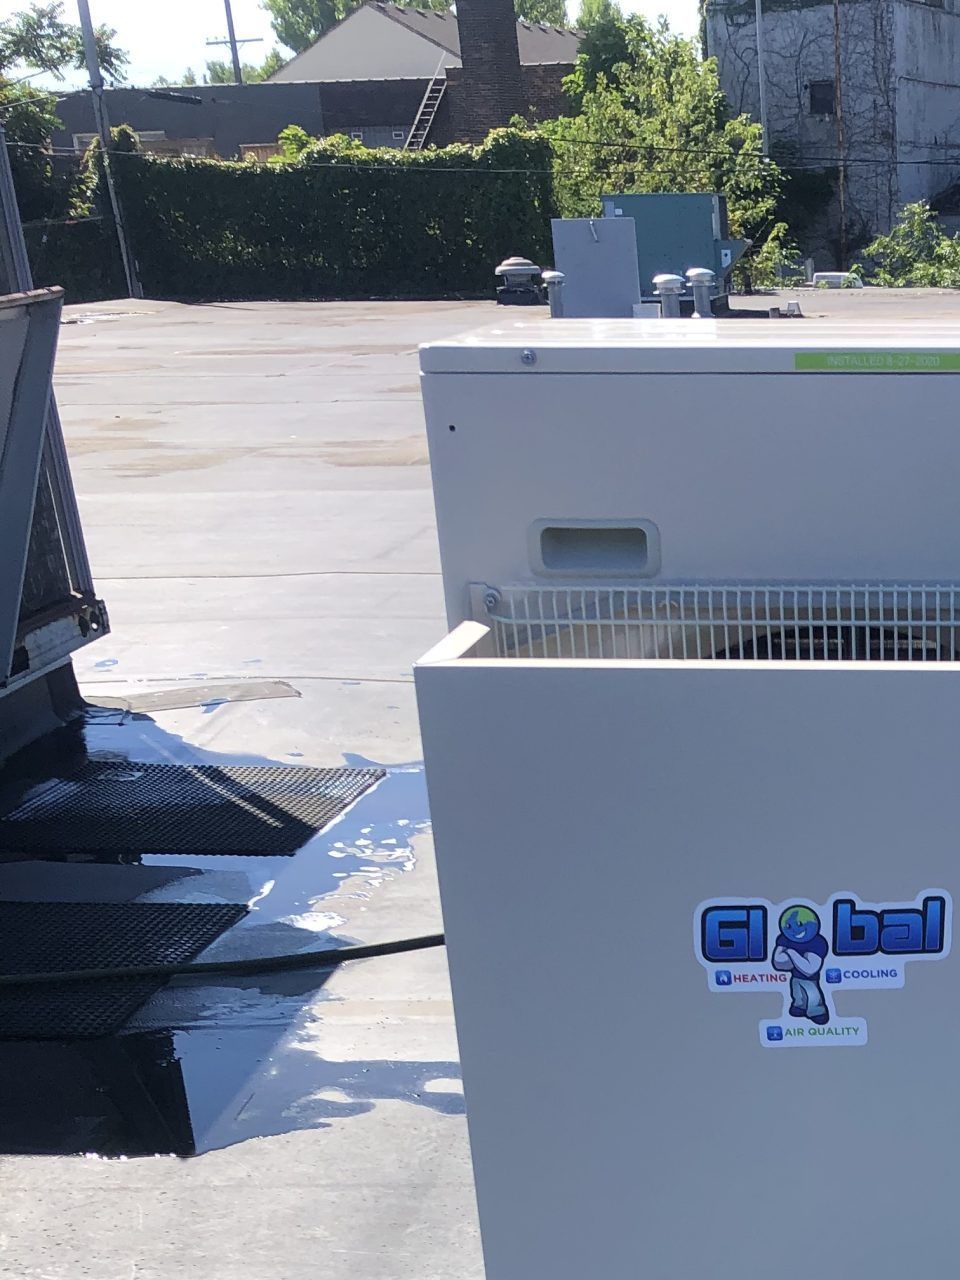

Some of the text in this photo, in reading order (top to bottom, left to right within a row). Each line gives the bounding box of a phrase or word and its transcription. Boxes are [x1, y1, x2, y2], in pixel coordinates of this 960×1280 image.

[827, 356, 883, 367] INSTALLED
[733, 974, 787, 983] HEATING
[843, 969, 897, 979] COOLING
[785, 1026, 860, 1037] AIR QUALITY
